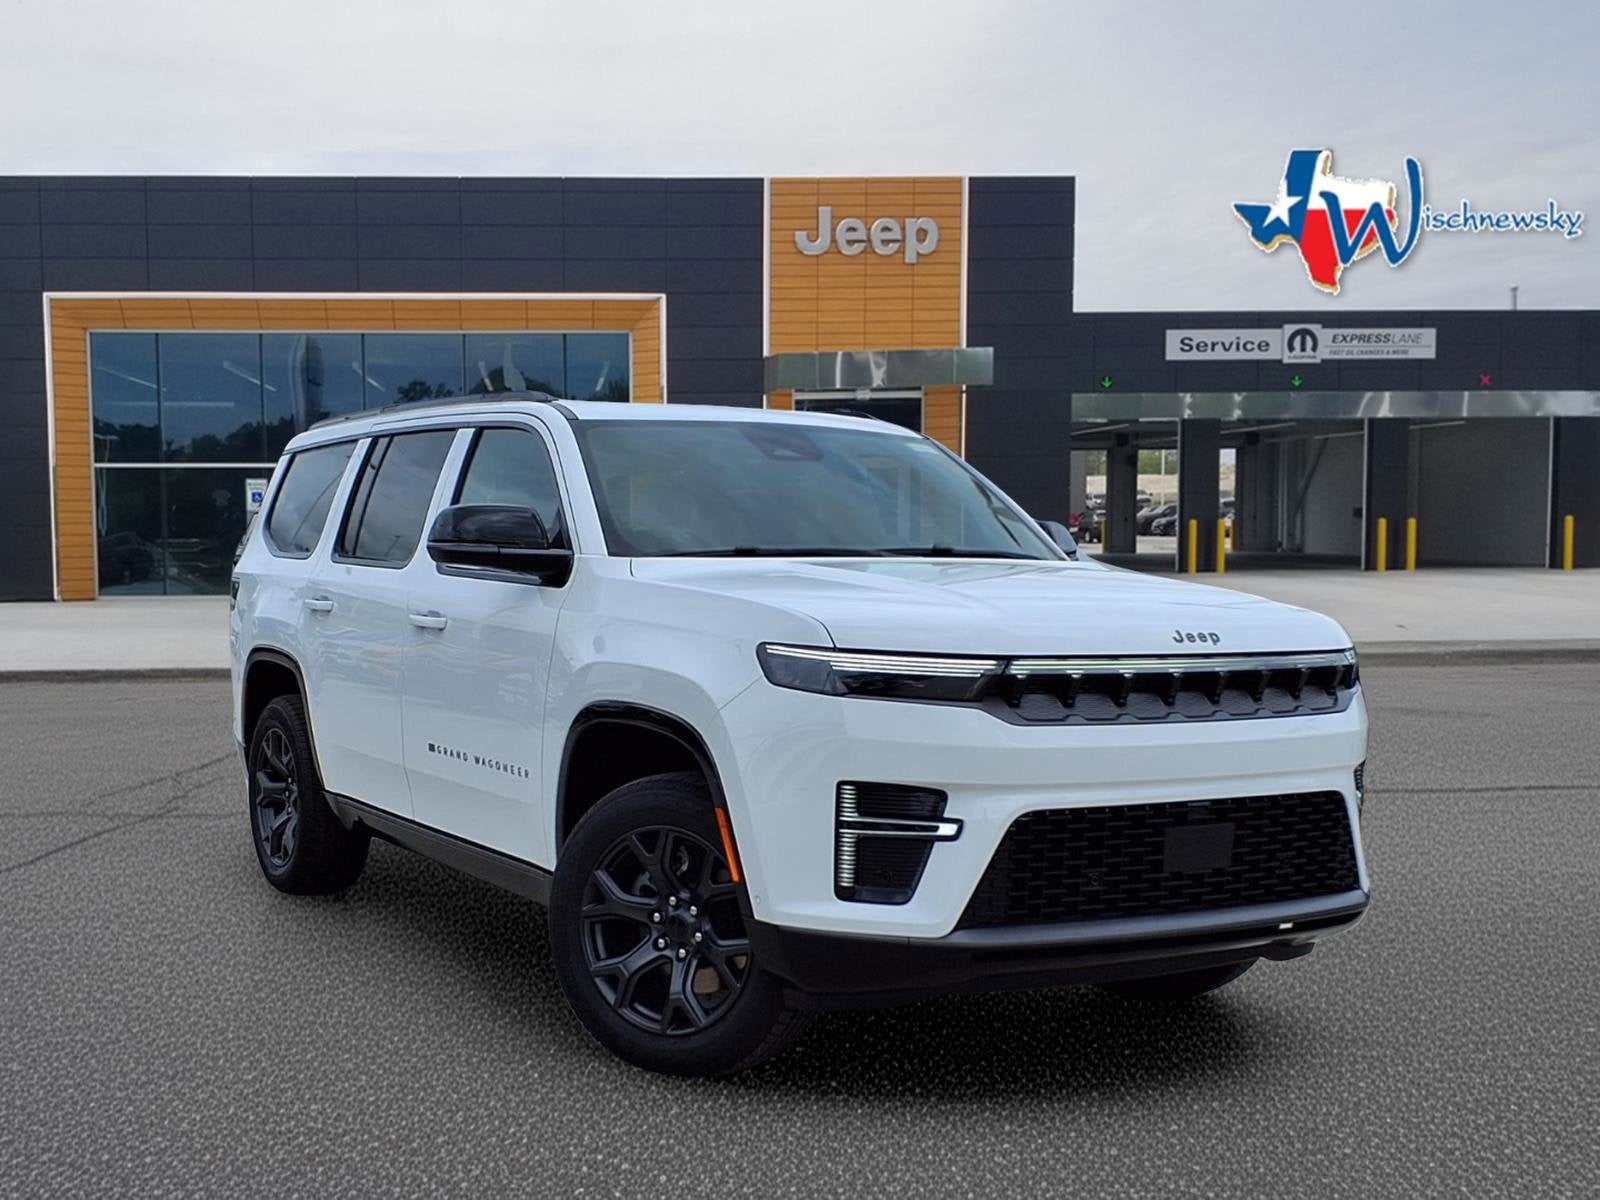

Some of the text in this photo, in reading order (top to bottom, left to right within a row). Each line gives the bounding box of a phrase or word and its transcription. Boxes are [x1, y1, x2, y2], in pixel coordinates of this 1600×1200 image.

[794, 205, 939, 264] Jeep
[1178, 336, 1271, 353] Service
[1172, 629, 1221, 646] Jeep
[436, 745, 530, 779] GRAND WAGONEER
